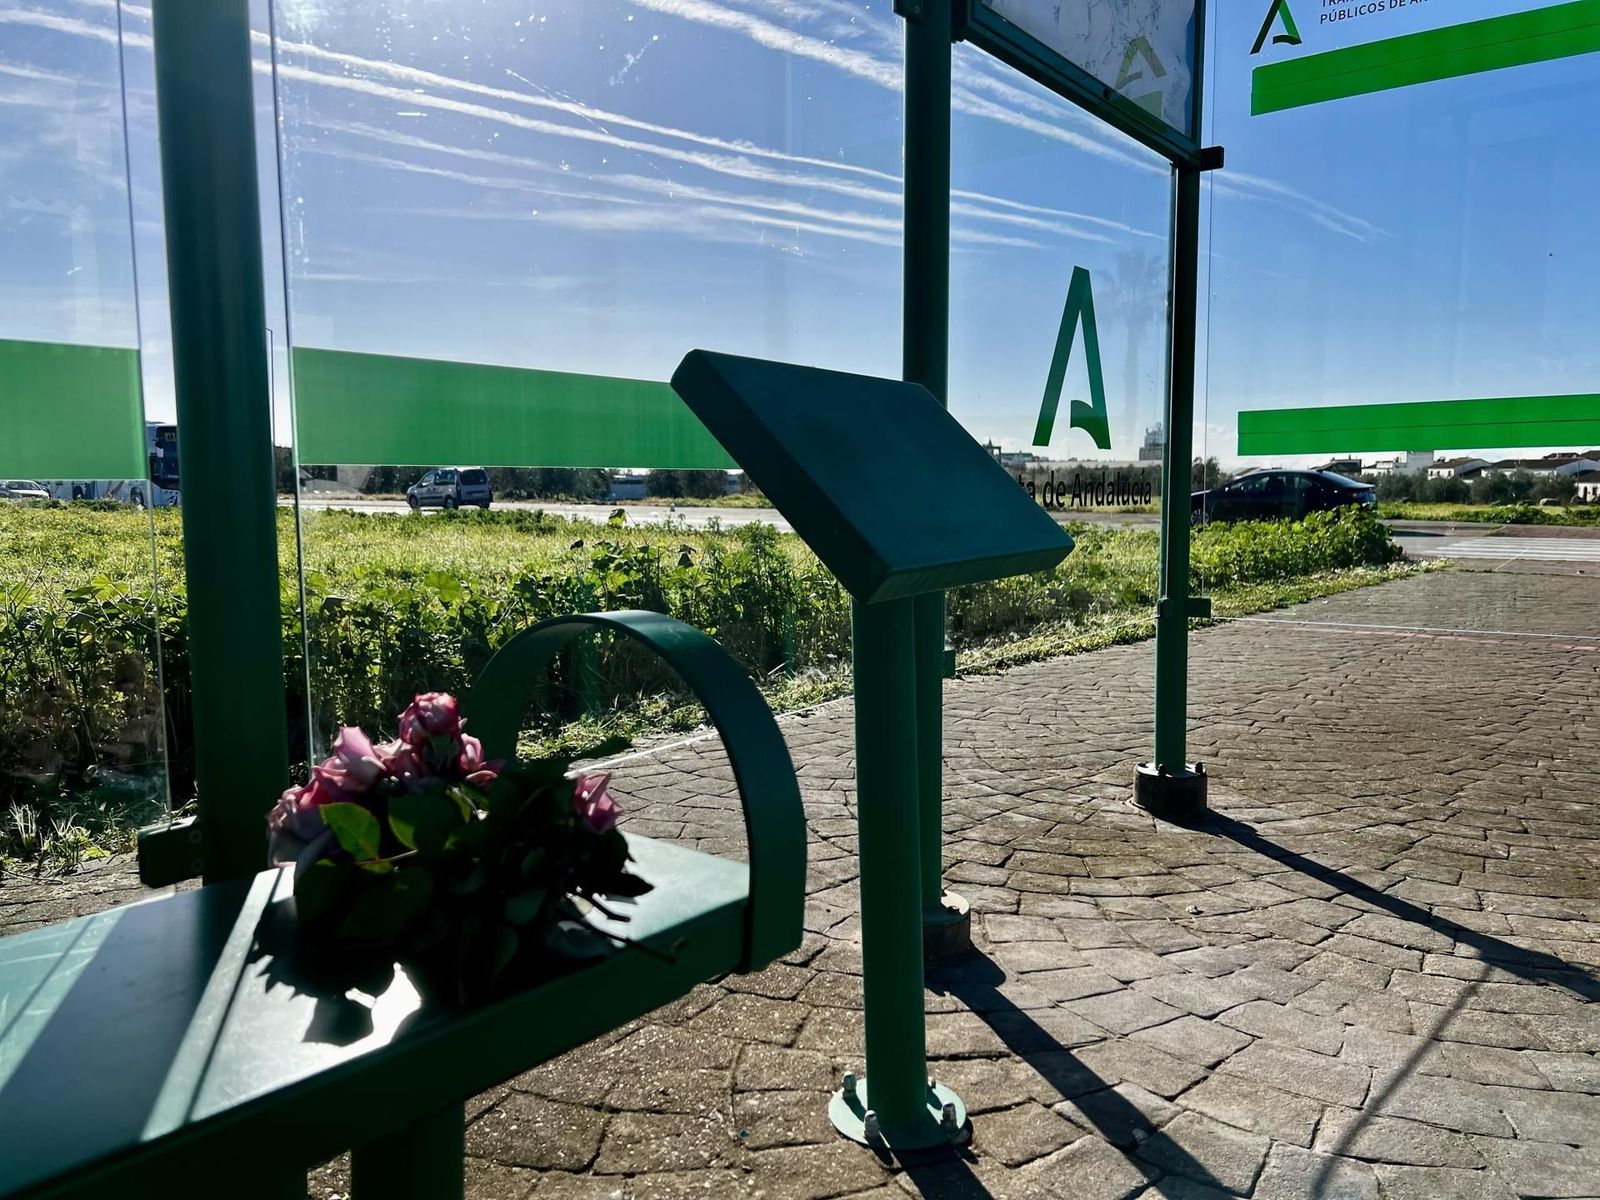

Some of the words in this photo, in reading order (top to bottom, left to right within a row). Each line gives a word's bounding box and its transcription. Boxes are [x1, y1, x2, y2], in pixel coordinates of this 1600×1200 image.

[1320, 1, 1385, 24] PÚBLICOS
[1043, 470, 1066, 508] de
[1070, 467, 1152, 507] Andalucía
